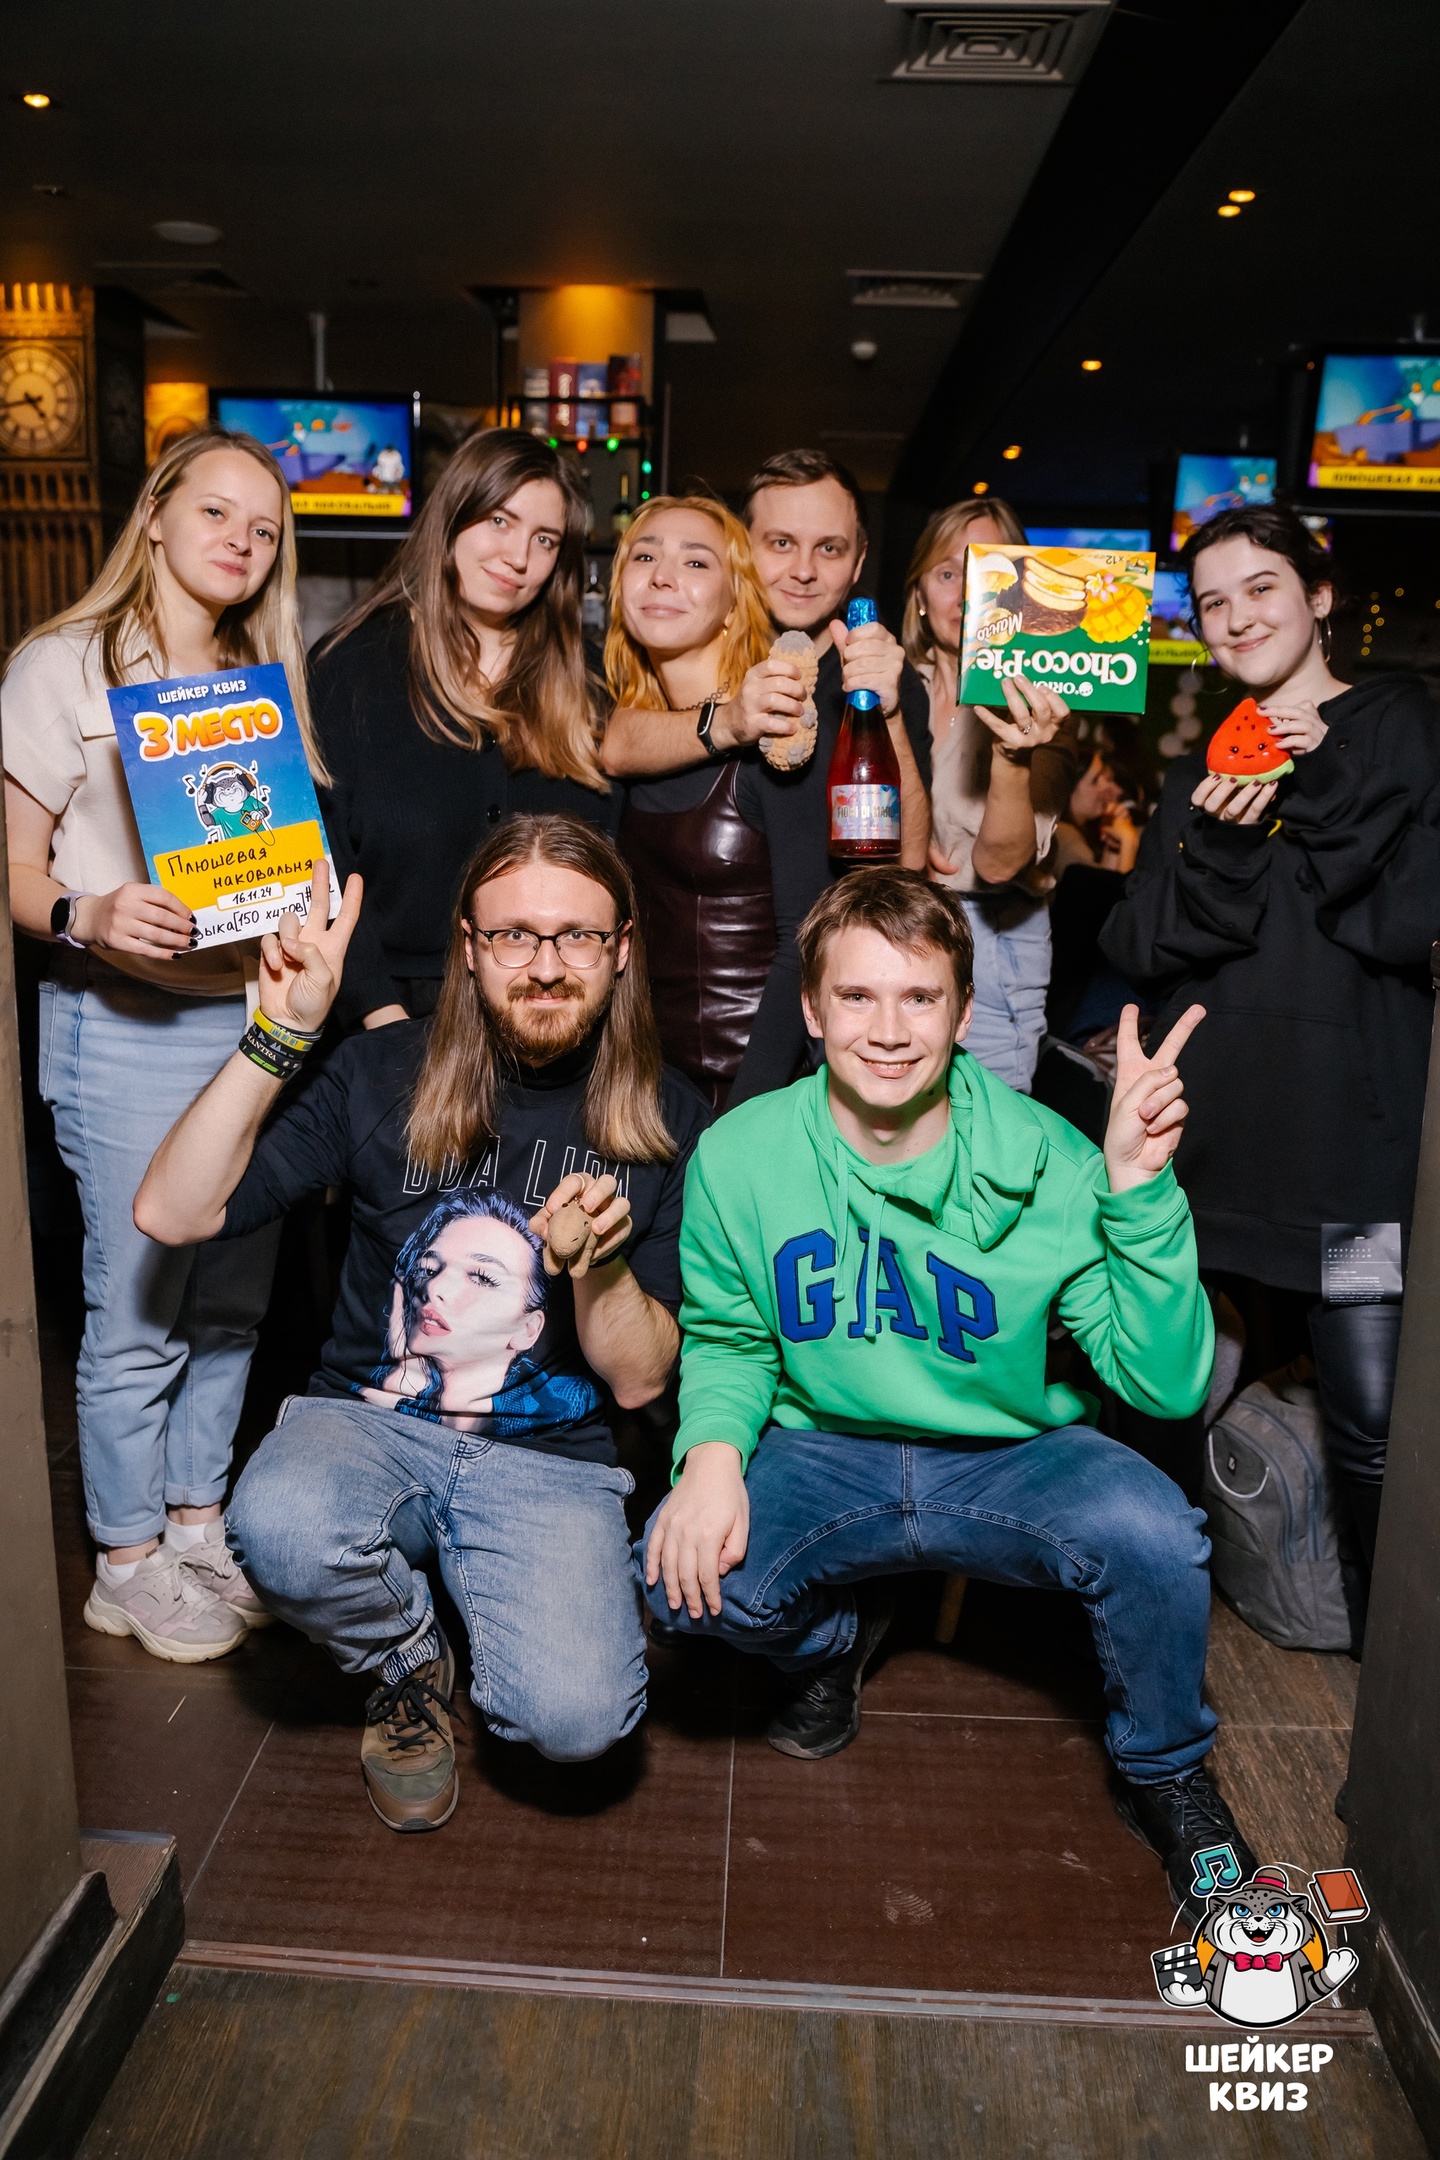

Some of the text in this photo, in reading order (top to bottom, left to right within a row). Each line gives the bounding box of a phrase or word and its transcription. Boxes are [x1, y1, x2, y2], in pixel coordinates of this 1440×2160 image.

[976, 611, 1024, 642] Манго
[157, 679, 248, 705] ШЕЙКЕР КВИЗ
[1031, 680, 1077, 695] ORIO
[137, 704, 281, 758] 3 МЕСТО
[167, 846, 269, 877] Плюшевая
[213, 858, 314, 889] наковальня
[231, 886, 273, 906] 16.11.24
[246, 1033, 277, 1062] MANTRA
[772, 1227, 1000, 1364] GAP
